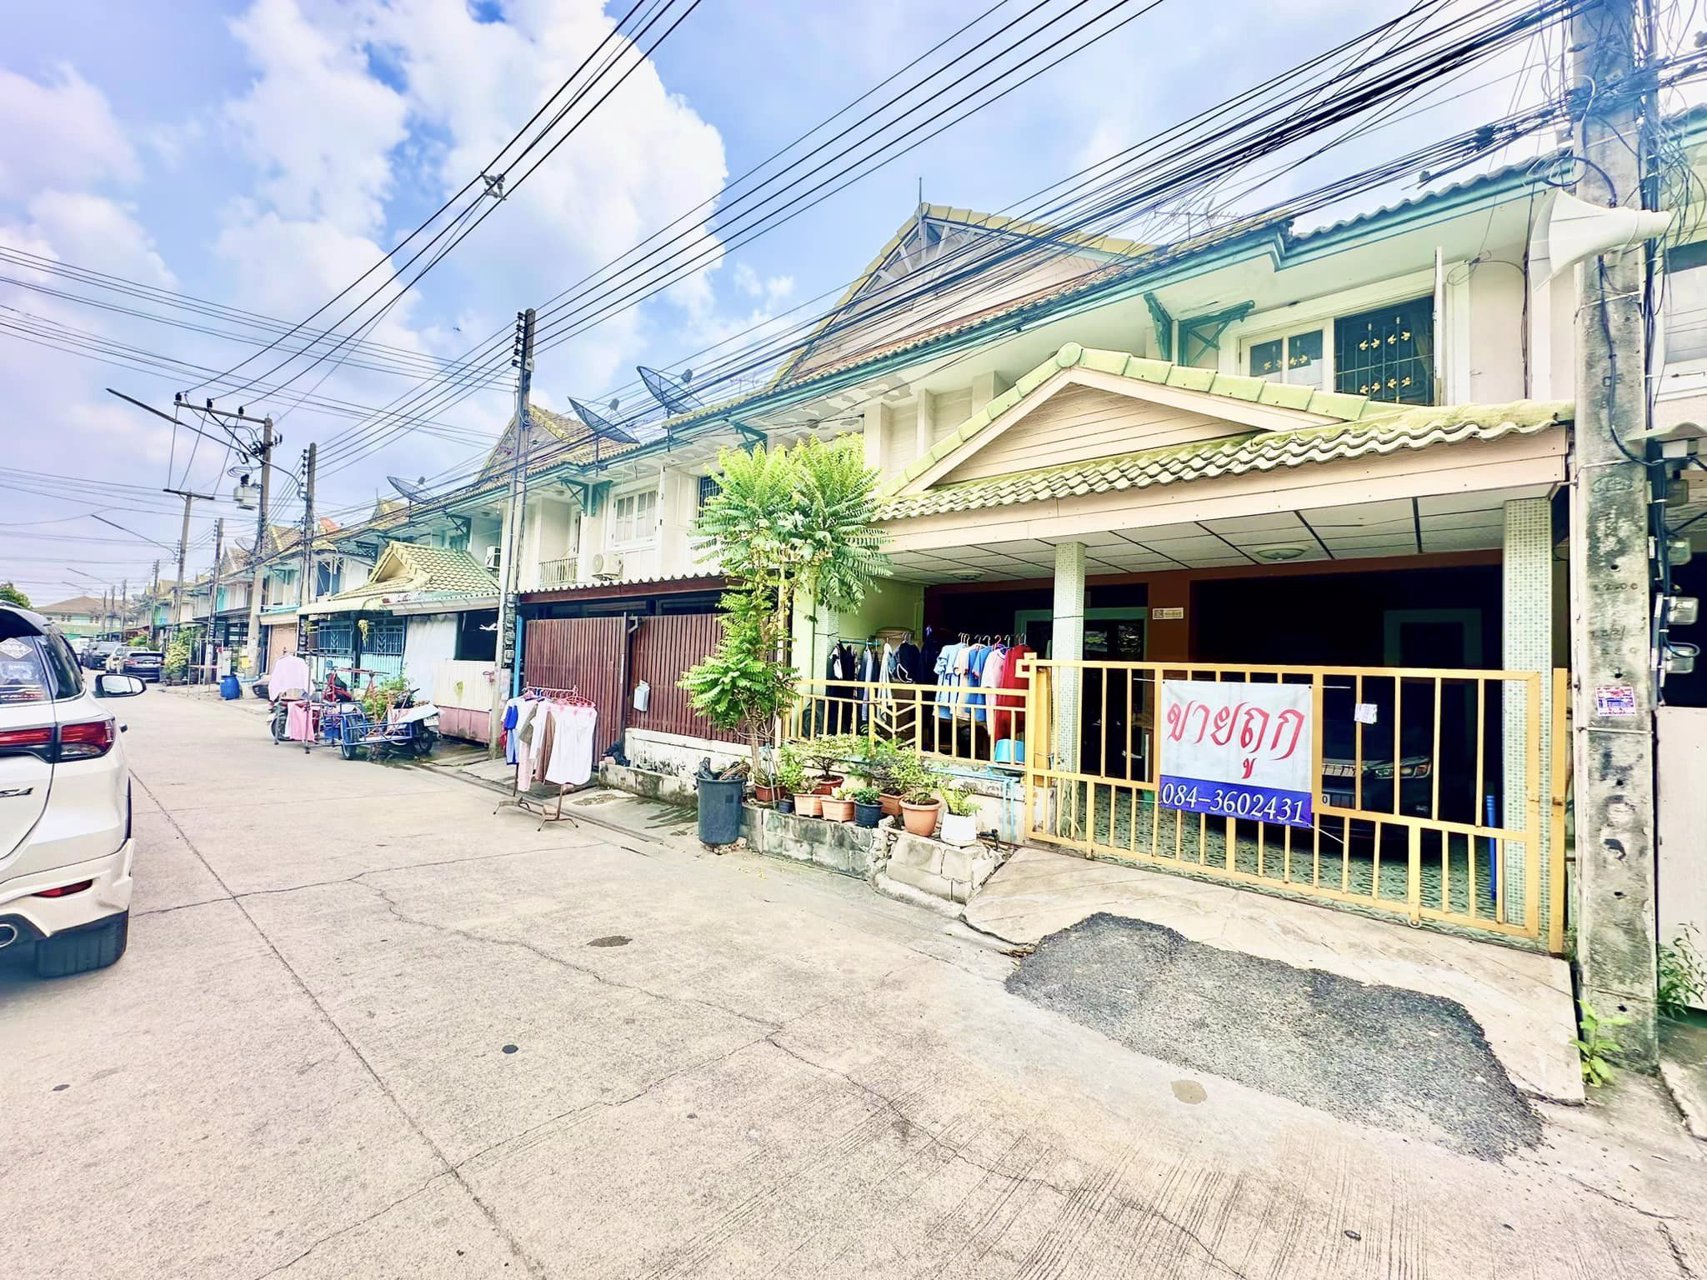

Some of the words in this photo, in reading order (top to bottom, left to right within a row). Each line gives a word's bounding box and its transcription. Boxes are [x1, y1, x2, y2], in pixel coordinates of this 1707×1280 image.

[1167, 700, 1305, 779] ขายถูก
[1162, 783, 1304, 824] 084-3602431
